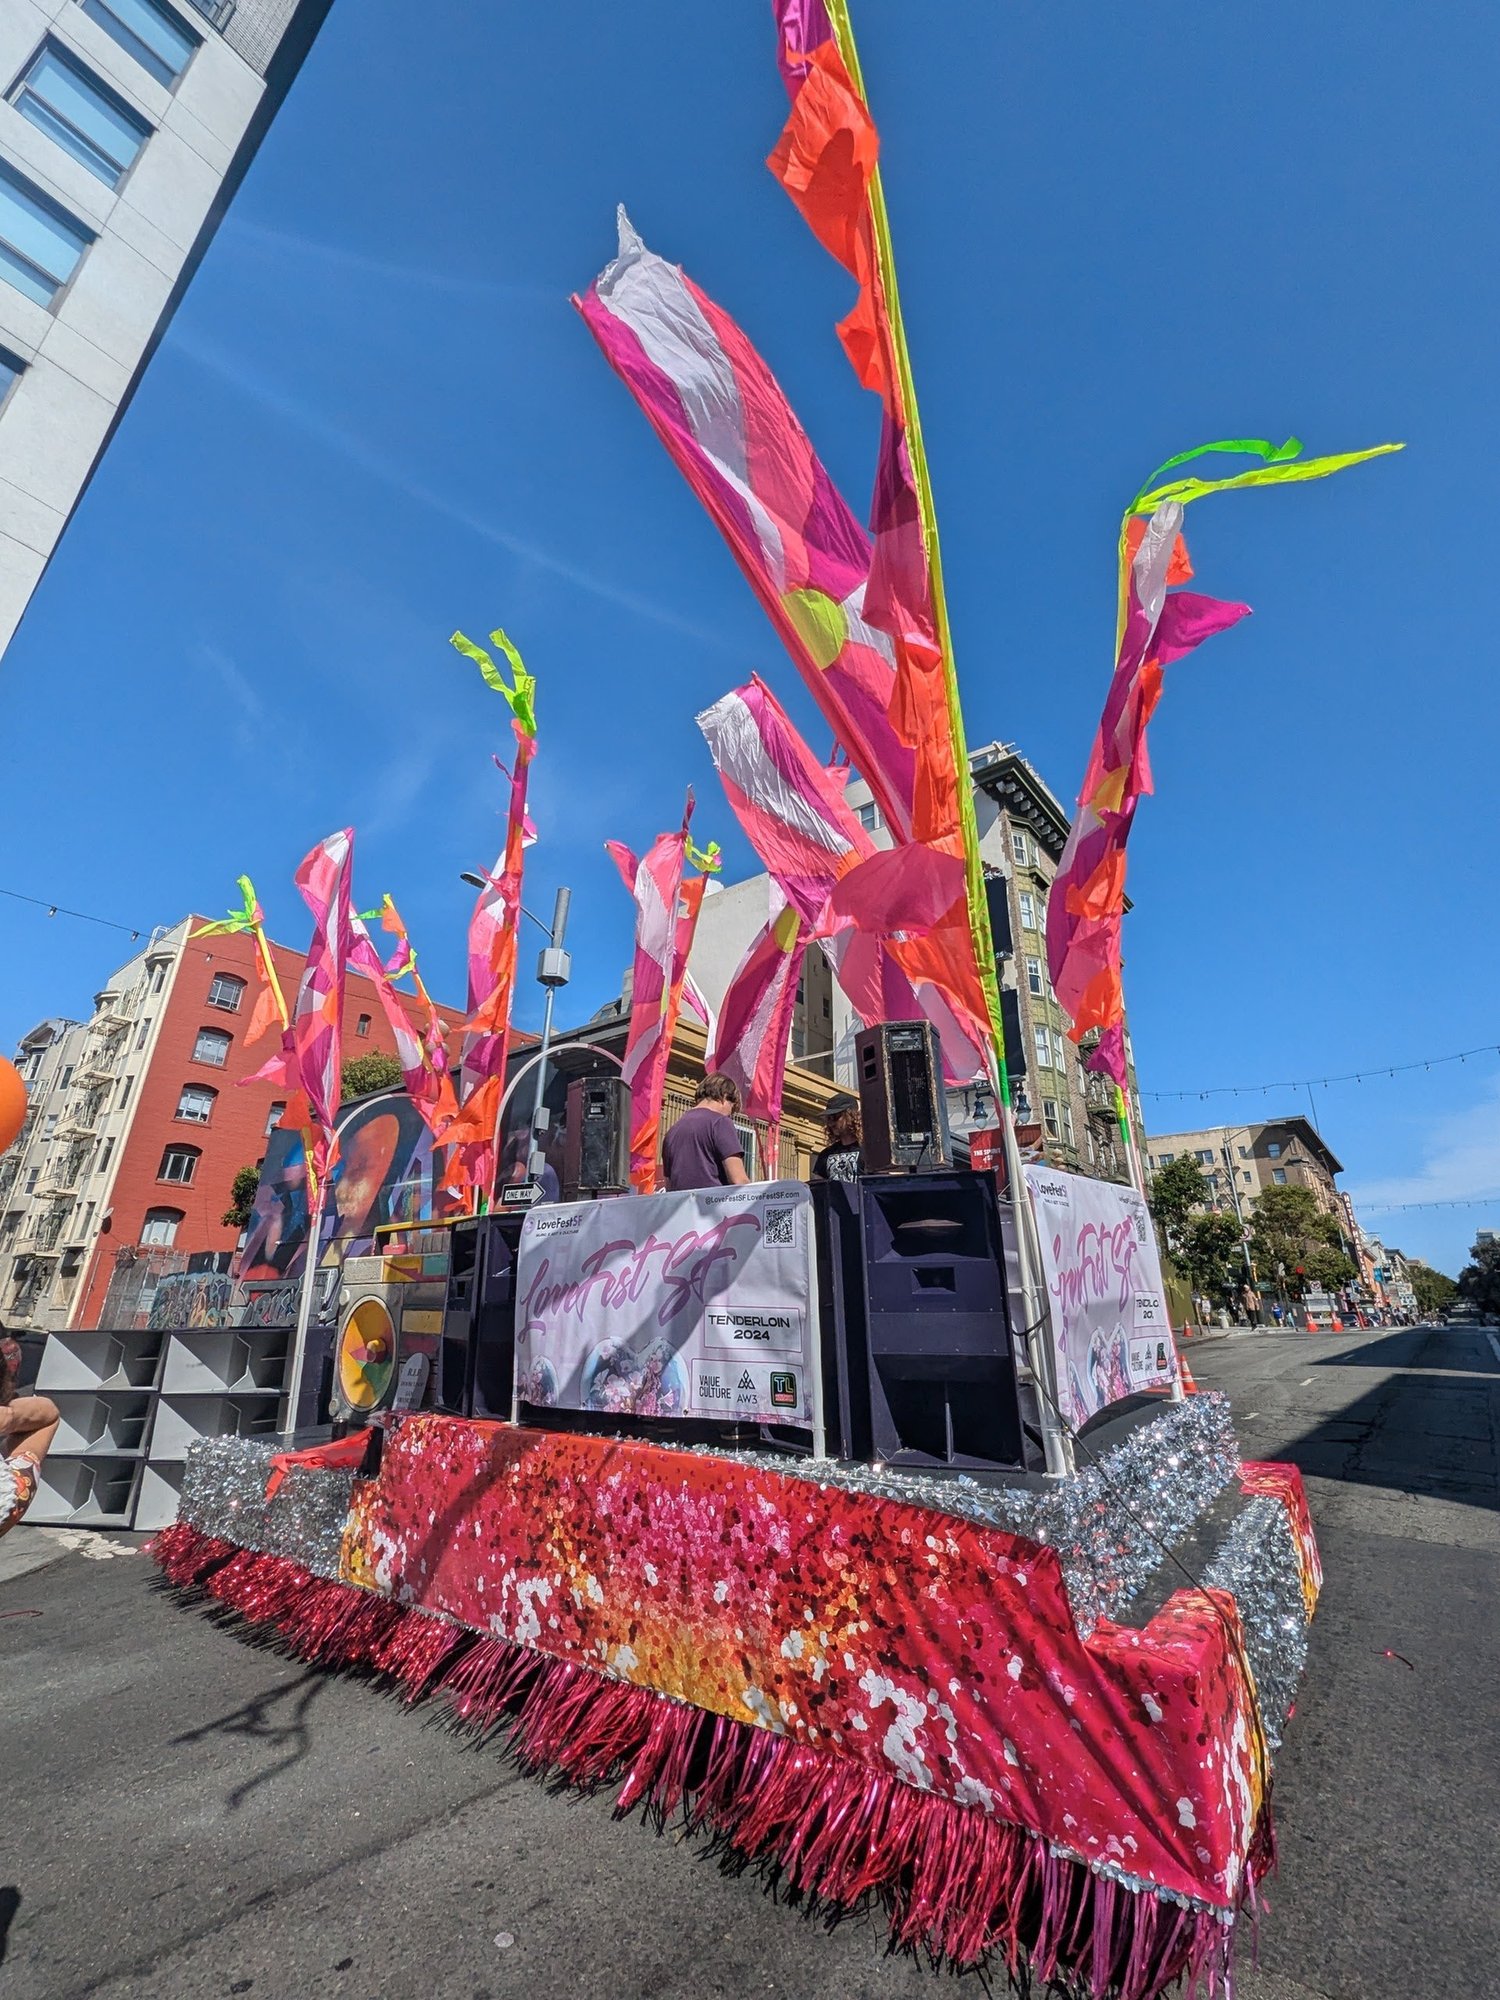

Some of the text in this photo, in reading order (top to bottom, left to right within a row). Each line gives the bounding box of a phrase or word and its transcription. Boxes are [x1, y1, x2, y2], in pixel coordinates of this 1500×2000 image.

[506, 1190, 532, 1199] ONE WAY
[747, 1191, 800, 1202] LoveFestSF.com
[1343, 1194, 1356, 1228] HOTEL
[537, 1215, 583, 1230] LoveFestSF
[708, 1314, 790, 1328] TENDERLOIN
[733, 1329, 770, 1341] 2024
[773, 1376, 794, 1393] TL
[699, 1386, 732, 1399] CULTURE
[736, 1393, 758, 1405] AW3
